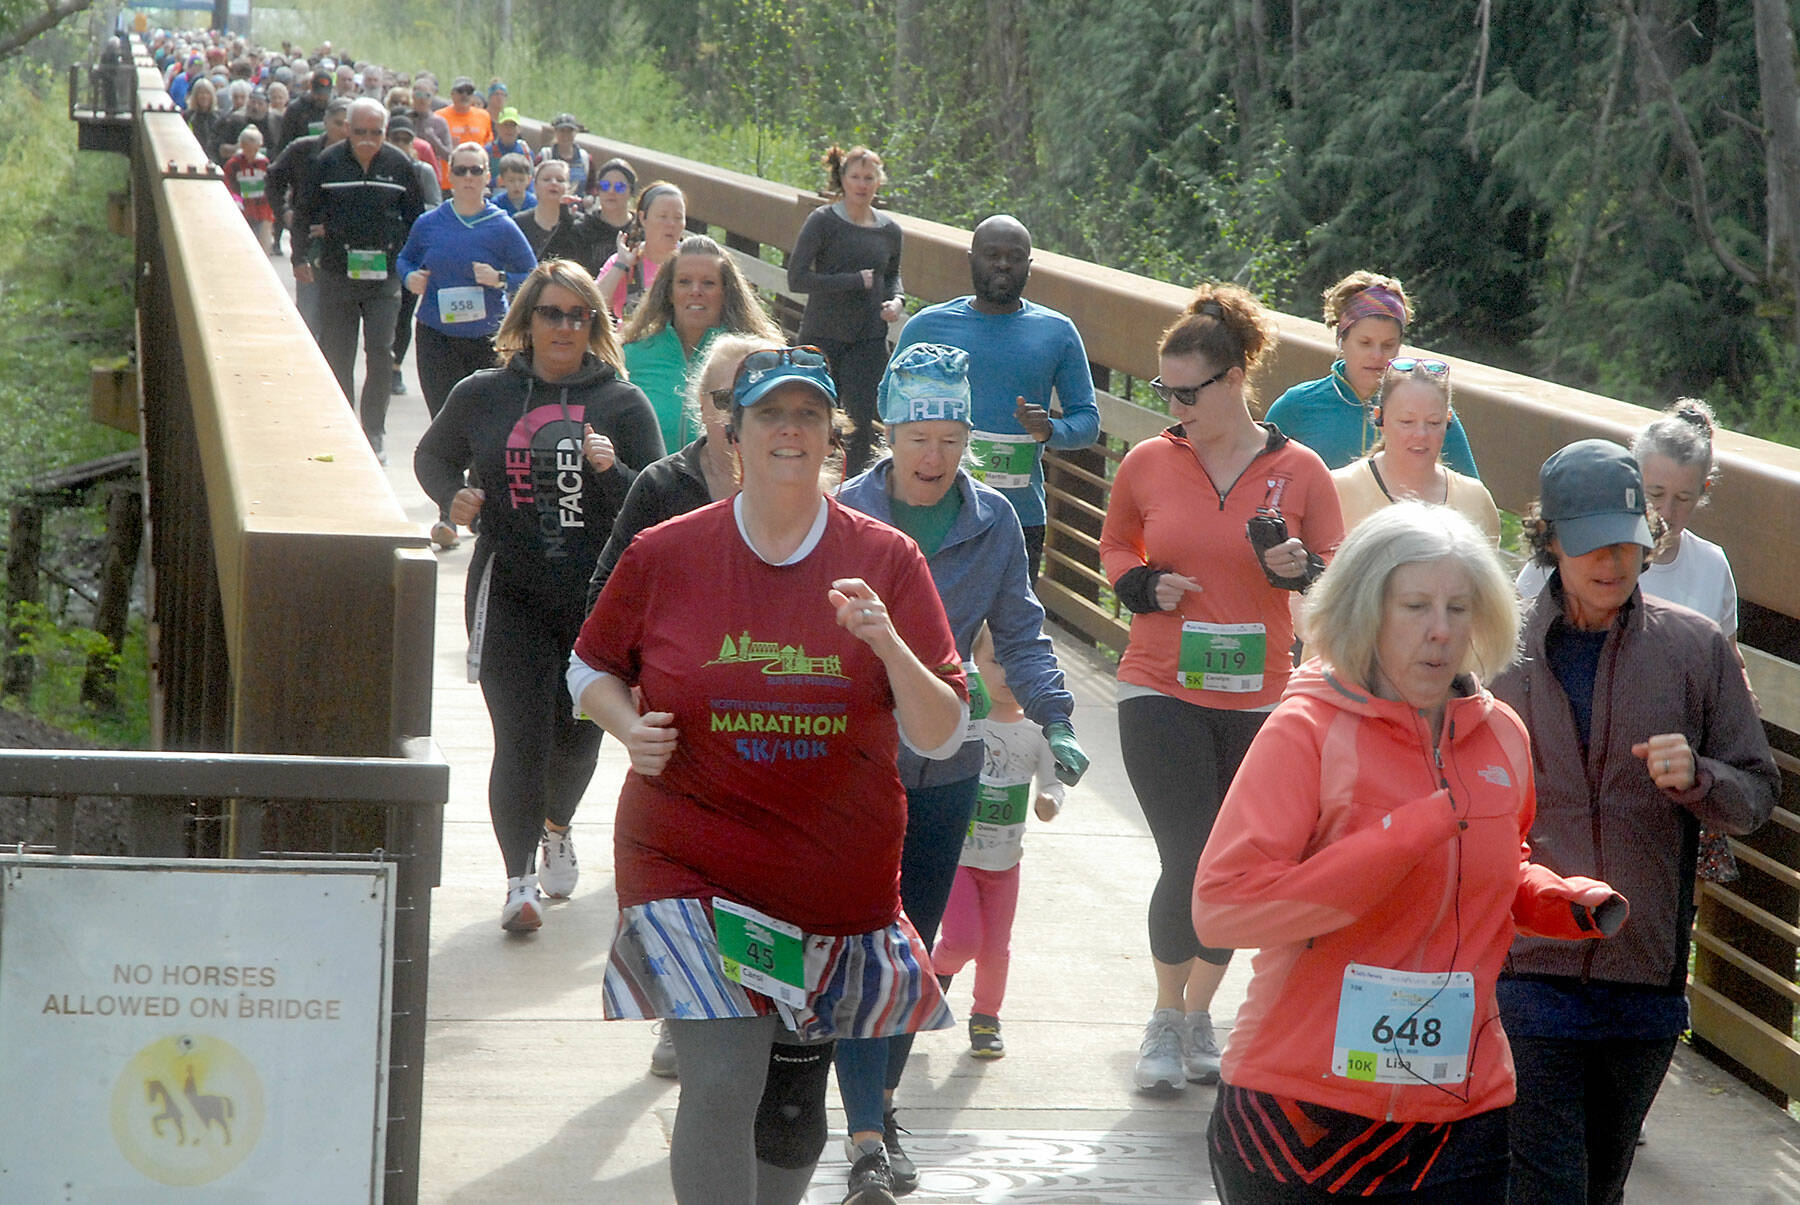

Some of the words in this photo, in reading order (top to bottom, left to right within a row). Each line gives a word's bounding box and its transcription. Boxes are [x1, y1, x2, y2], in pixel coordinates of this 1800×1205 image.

[450, 300, 474, 311] 558
[991, 456, 1010, 470] 91
[505, 450, 535, 509] THE
[556, 451, 585, 527] FACE
[1205, 652, 1246, 670] 119
[1186, 675, 1201, 684] 5K
[711, 712, 848, 736] MARATHON
[736, 738, 828, 764] 5K/10K
[976, 800, 1013, 820] 120
[747, 942, 775, 969] 45
[113, 964, 153, 985] NO
[163, 965, 276, 988] HORSES
[42, 994, 180, 1017] ALLOWED
[190, 997, 229, 1019] ON
[238, 999, 341, 1020] BRIDGE
[1372, 1015, 1442, 1047] 648
[1348, 1059, 1372, 1072] 10K
[1386, 1057, 1412, 1069] Lisa
